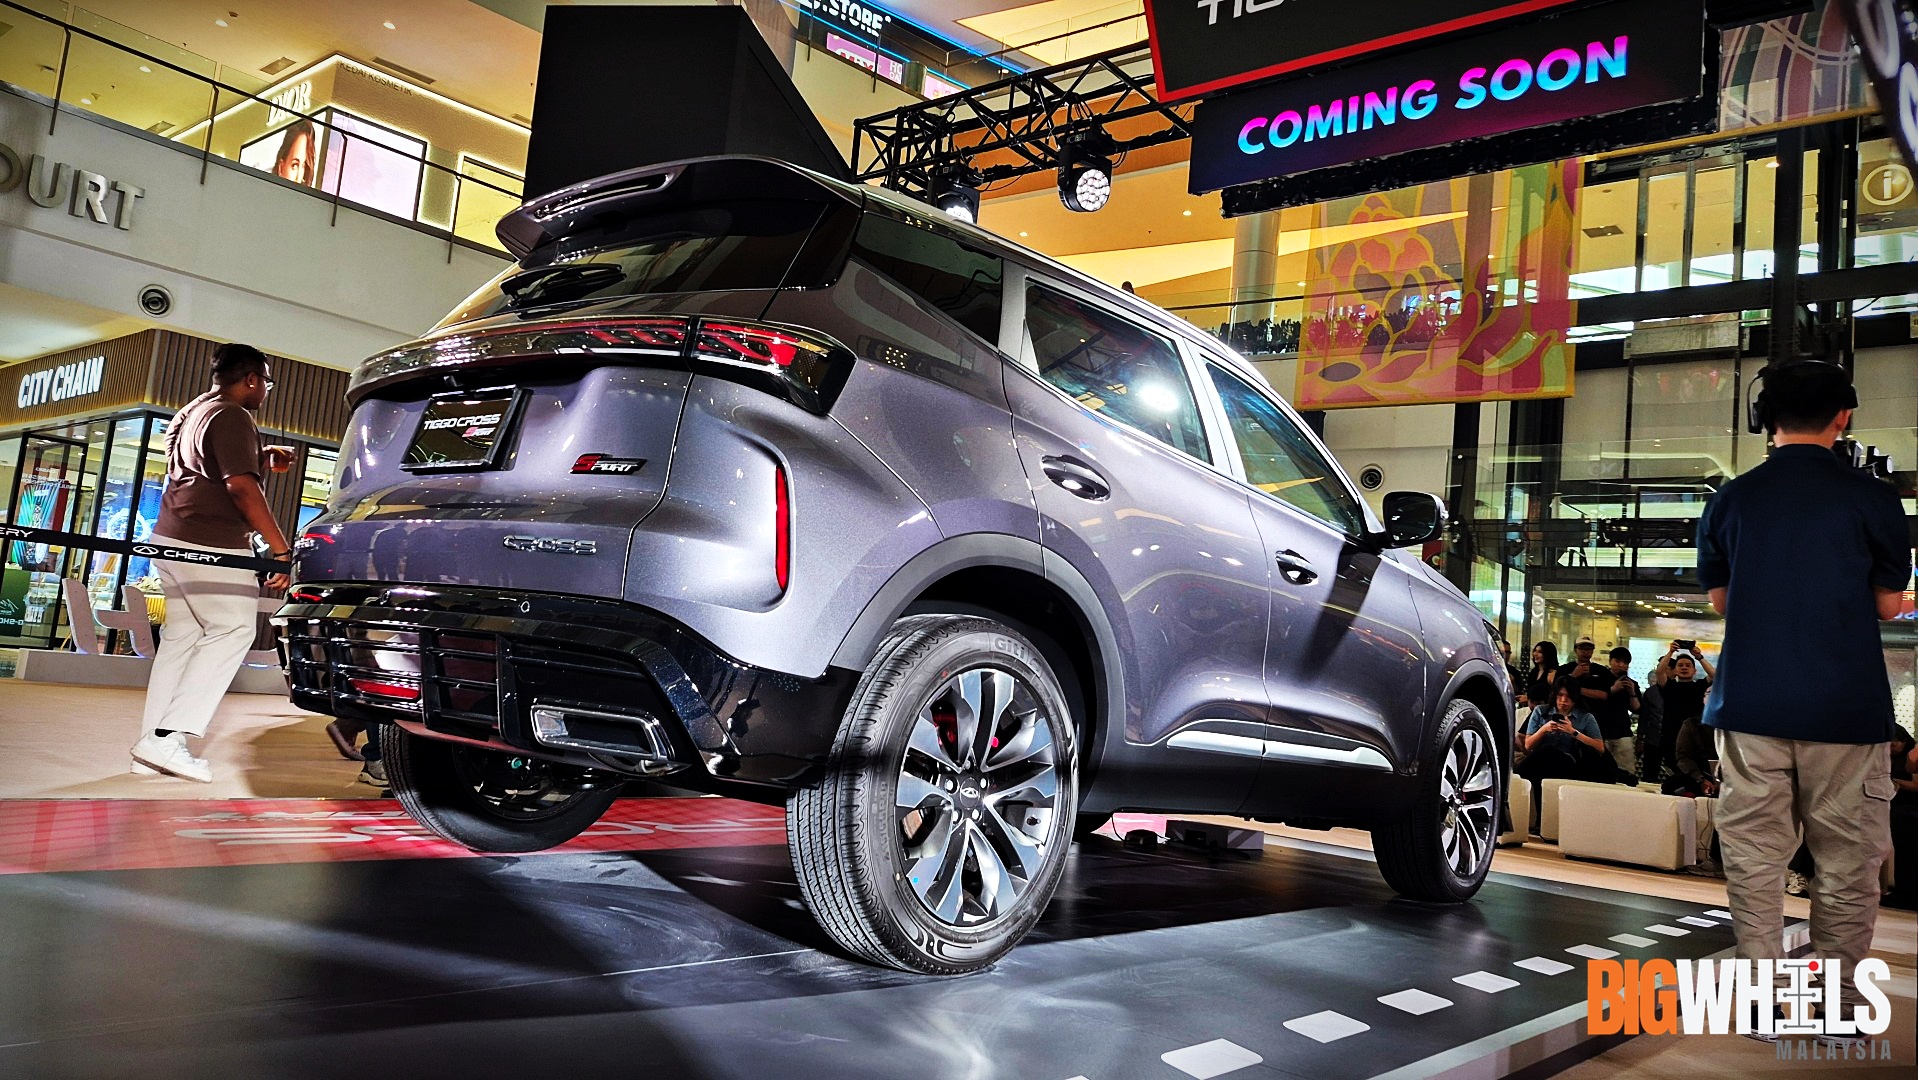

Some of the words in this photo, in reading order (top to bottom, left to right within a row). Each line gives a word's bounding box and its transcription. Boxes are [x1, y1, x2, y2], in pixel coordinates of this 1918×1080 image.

[368, 73, 412, 96] KOSMETIK
[1237, 79, 1438, 155] COMING
[1454, 35, 1628, 110] SOON
[17, 368, 54, 409] CITY
[52, 356, 104, 402] CHAIN
[424, 417, 458, 430] TIGGO
[456, 413, 501, 427] CROSS
[462, 426, 496, 438] SPORT
[569, 454, 639, 474] SPORT
[503, 534, 597, 555] CROSS
[163, 550, 222, 563] CHERY
